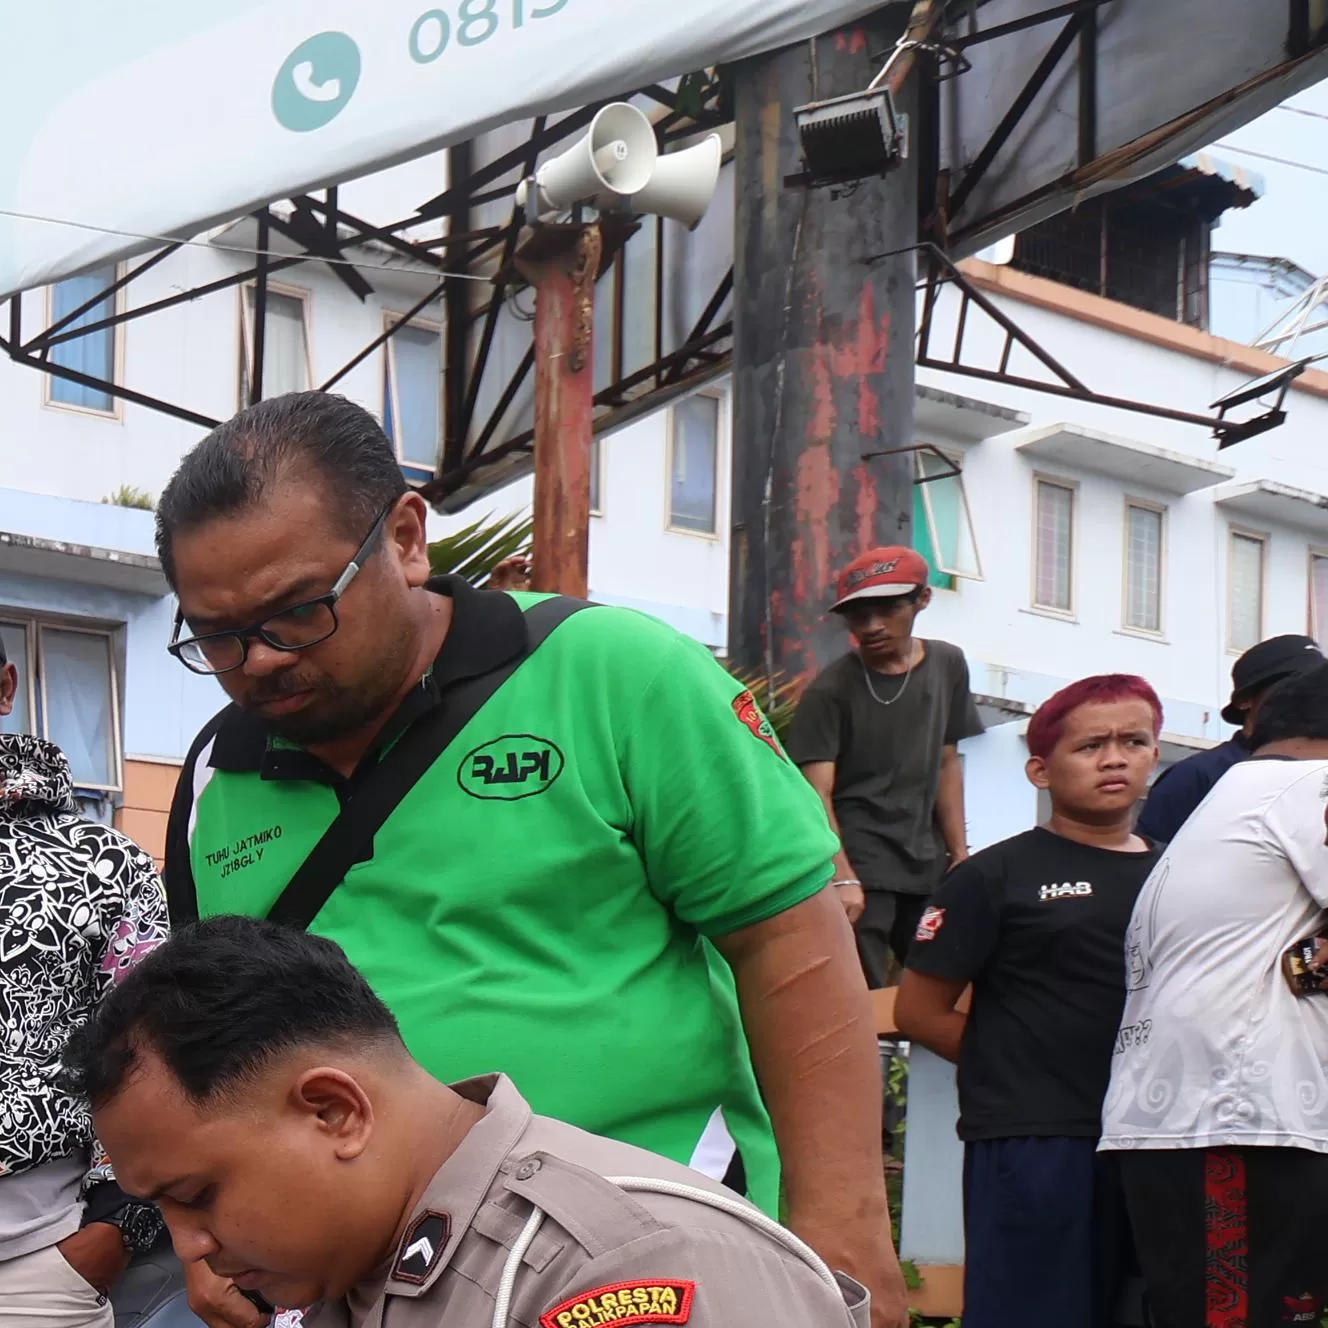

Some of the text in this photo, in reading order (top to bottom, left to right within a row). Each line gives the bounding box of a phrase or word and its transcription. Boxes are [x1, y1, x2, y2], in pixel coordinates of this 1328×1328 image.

[471, 750, 550, 784] RAPI
[205, 825, 282, 867] TUHU JATMIKO
[1039, 881, 1092, 899] HAB
[557, 1287, 676, 1328] POLRESTA
